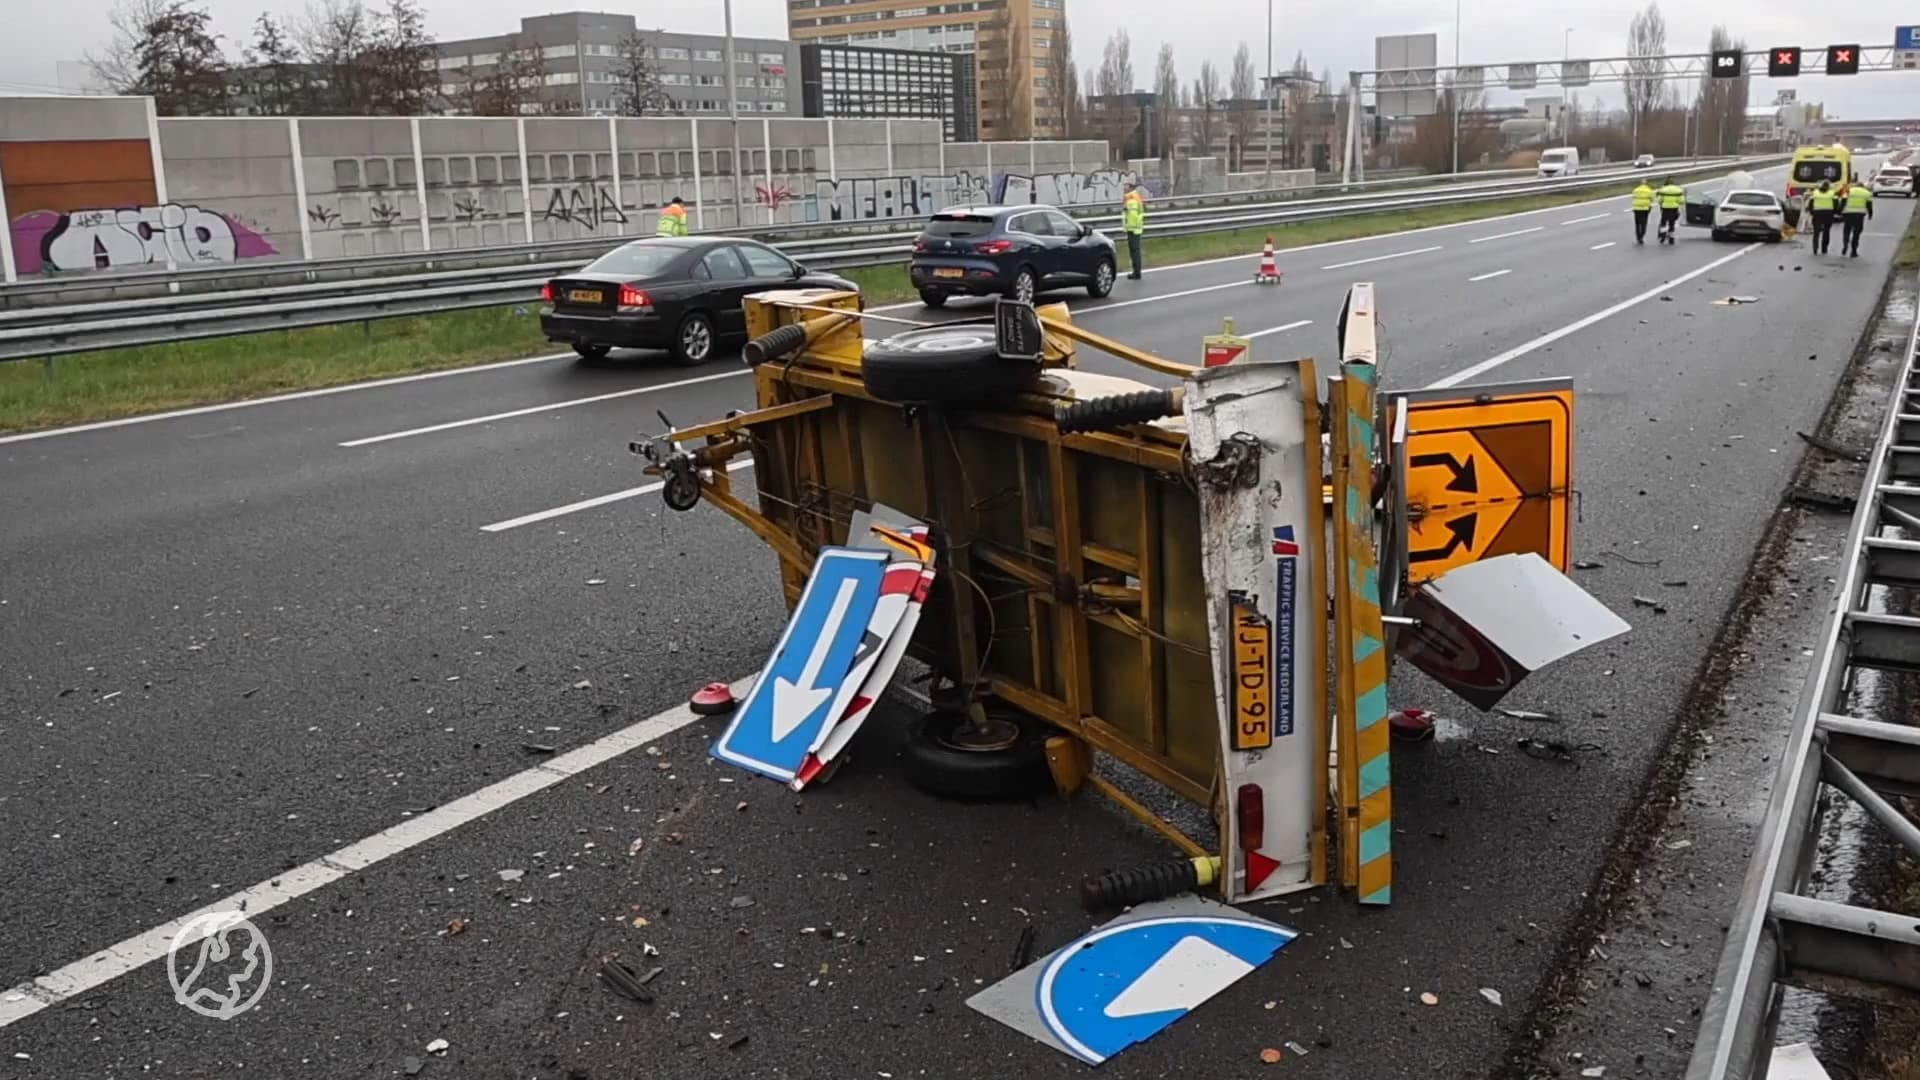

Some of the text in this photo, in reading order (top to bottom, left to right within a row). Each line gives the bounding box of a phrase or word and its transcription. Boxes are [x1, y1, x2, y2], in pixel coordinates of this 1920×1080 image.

[1718, 56, 1734, 67] 50
[1280, 560, 1293, 734] TRAFFIC SERVICE NEDERLAND
